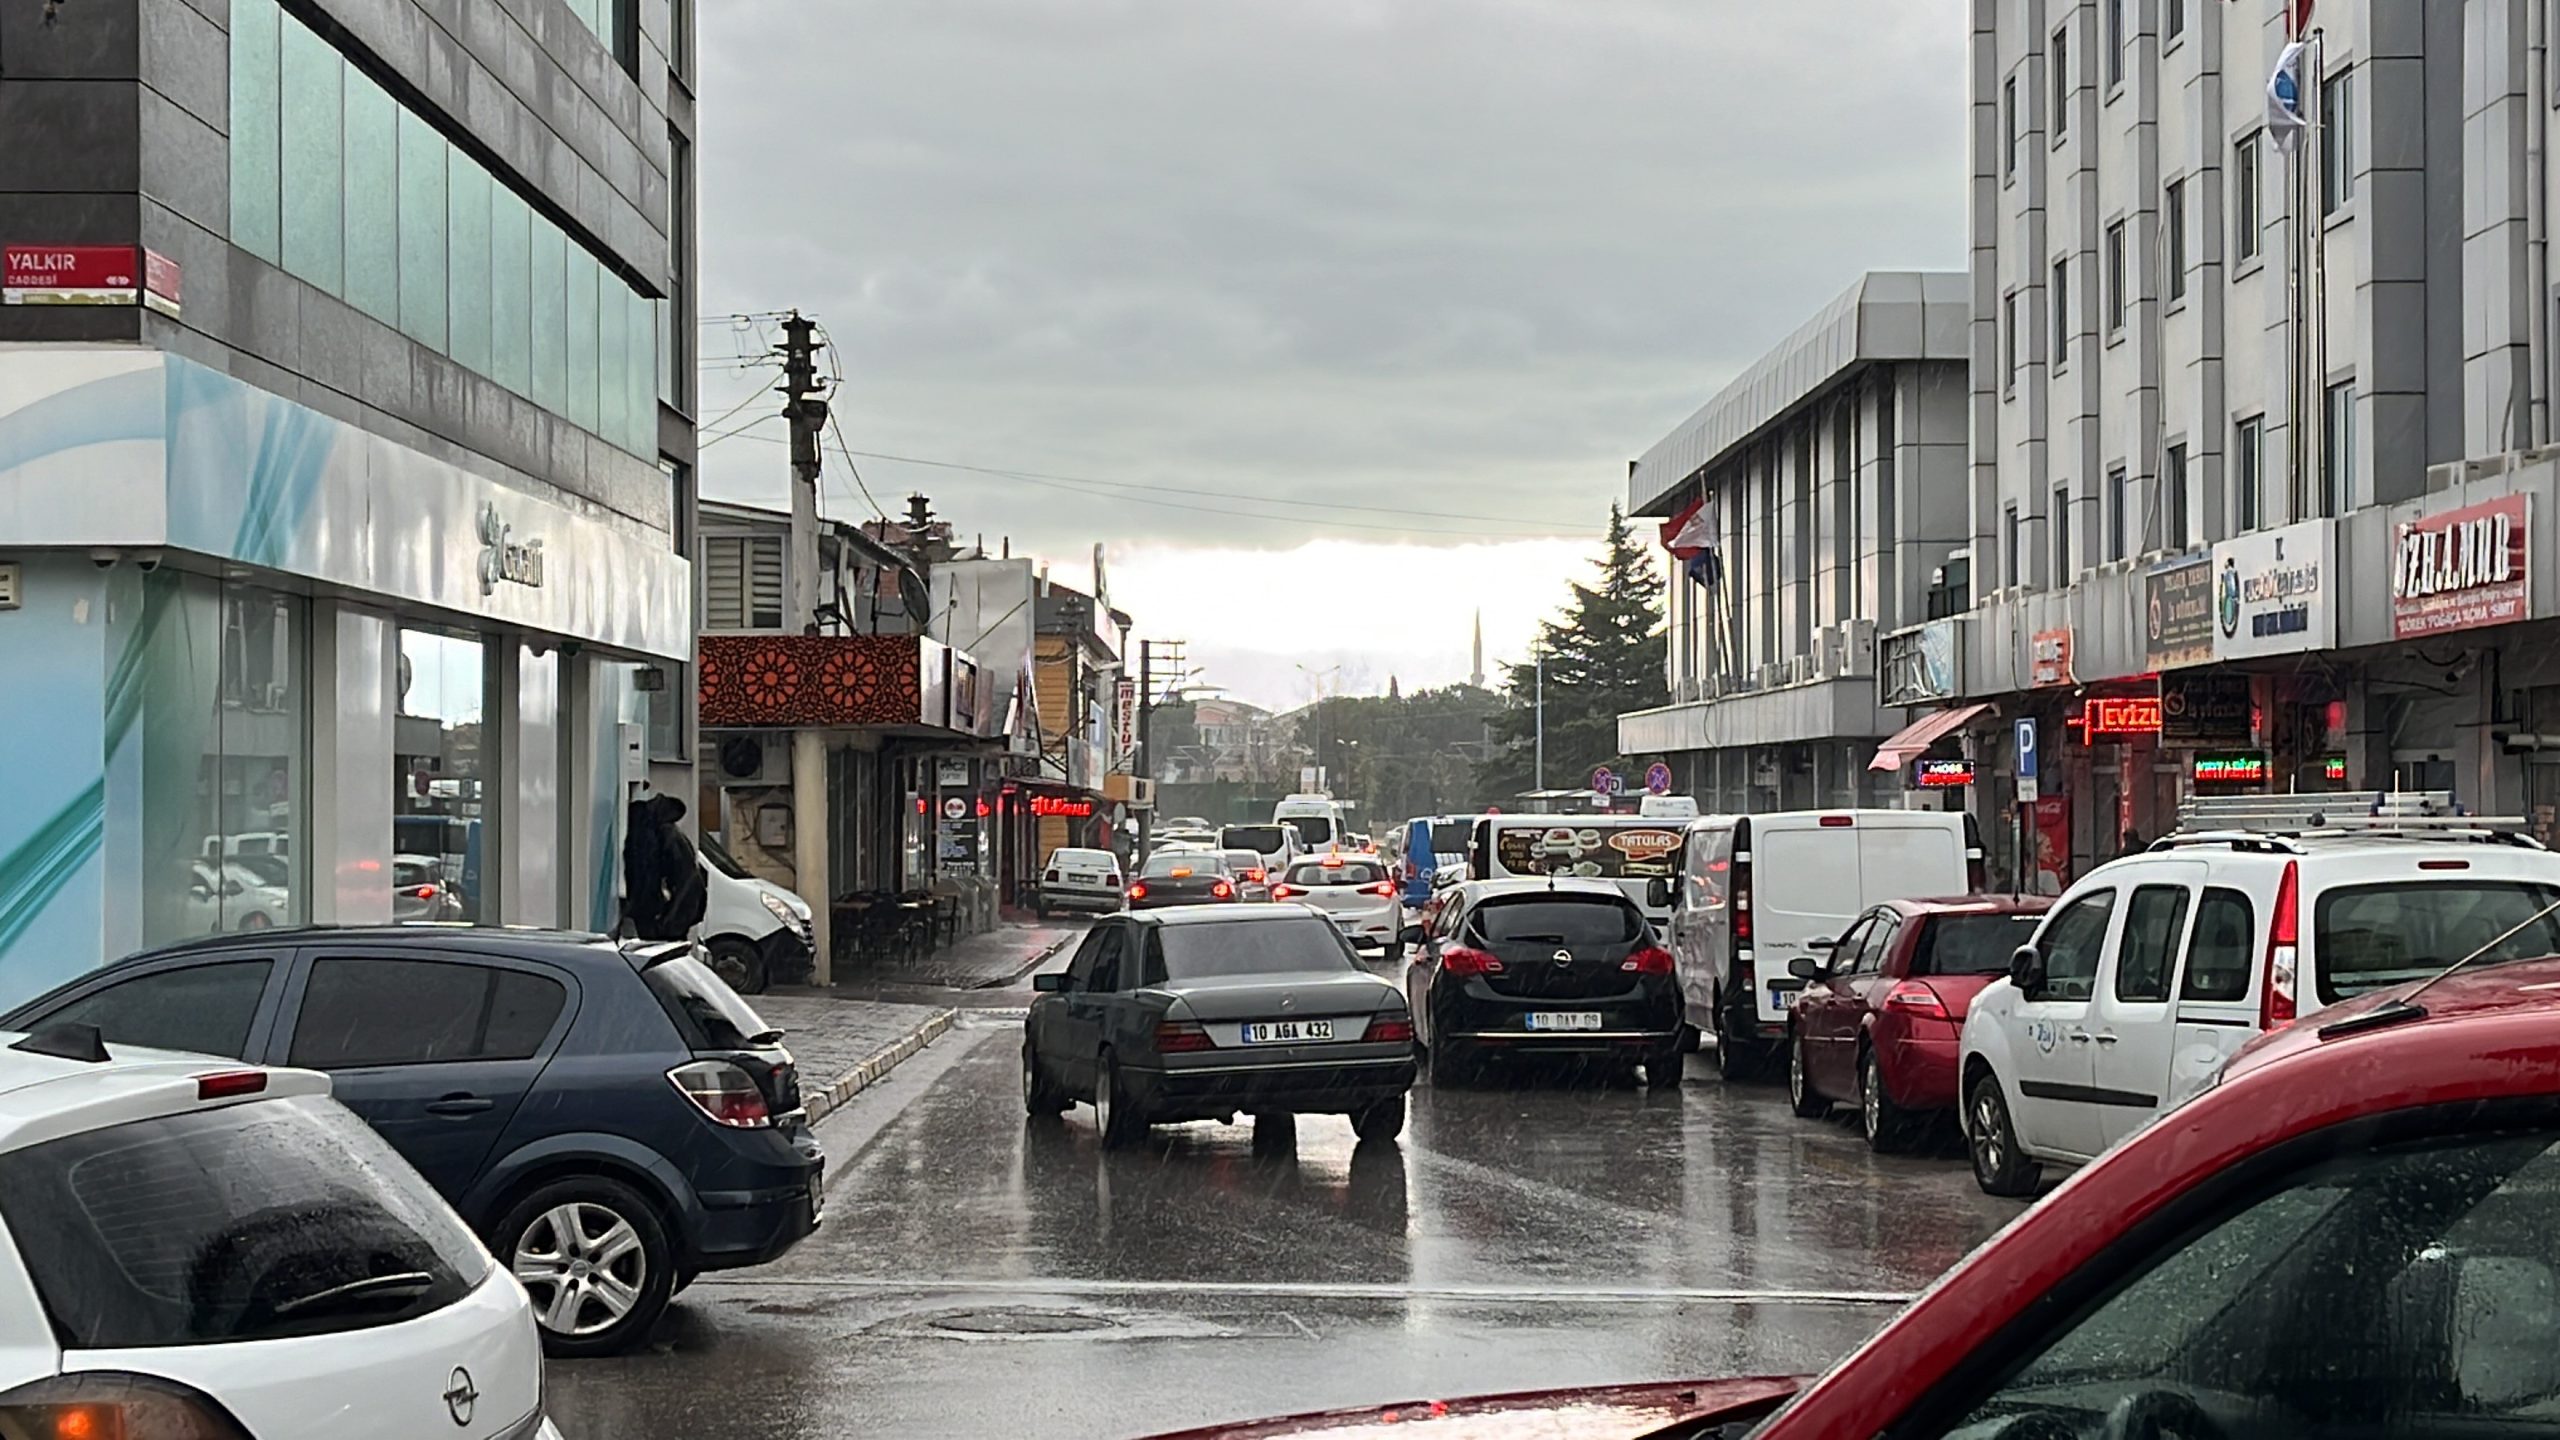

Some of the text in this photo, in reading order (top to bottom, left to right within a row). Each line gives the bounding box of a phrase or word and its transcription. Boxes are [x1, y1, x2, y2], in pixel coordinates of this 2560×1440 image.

[8, 253, 76, 271] YALKIR
[2020, 723, 2033, 773] P
[1536, 1014, 1549, 1026] 10
[1252, 1021, 1330, 1041] 10 AGA 432
